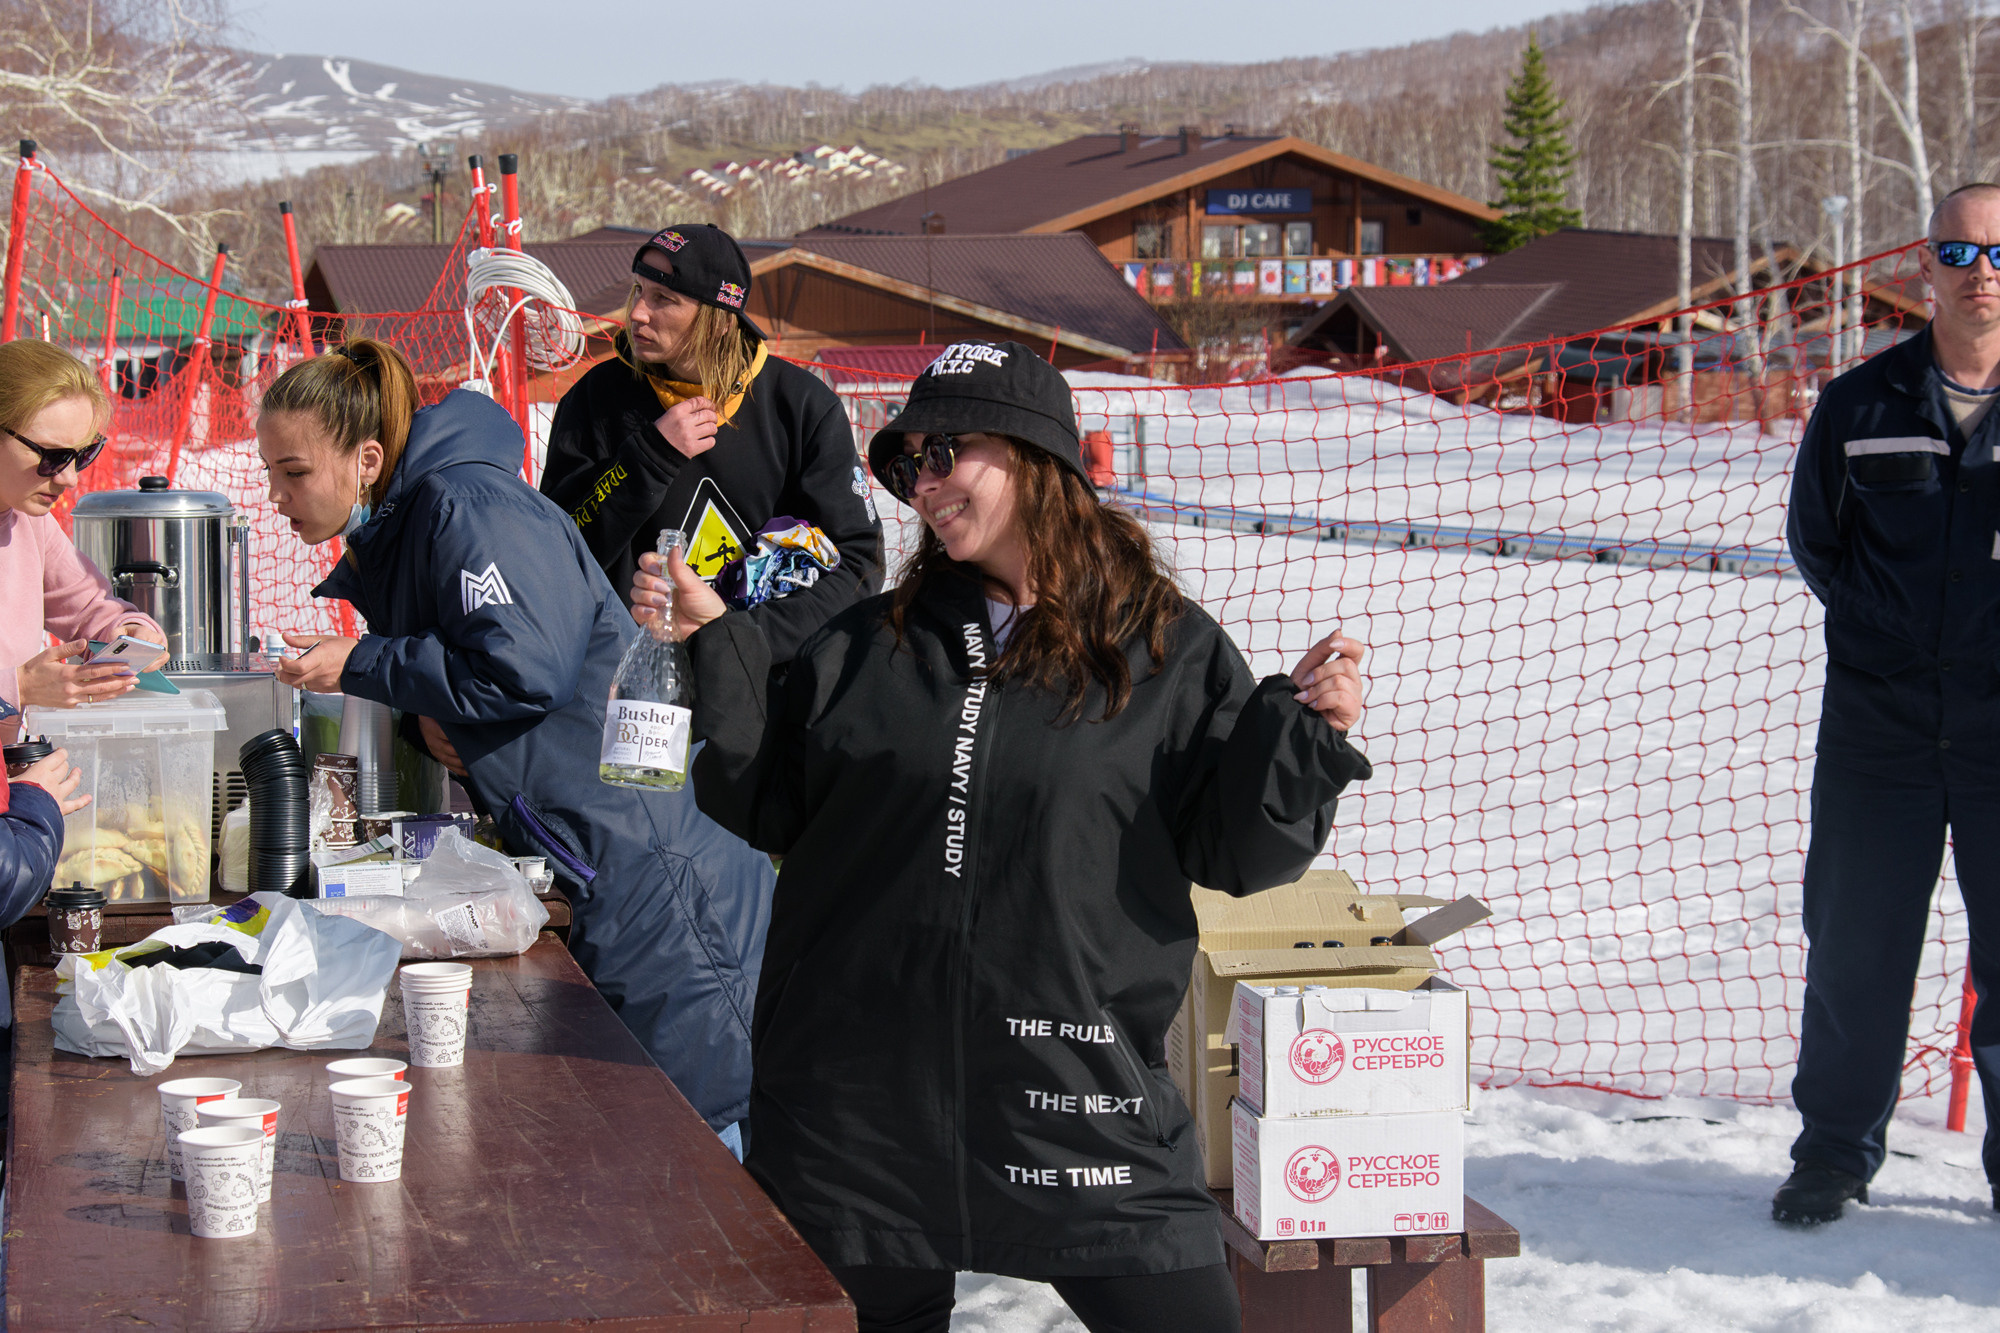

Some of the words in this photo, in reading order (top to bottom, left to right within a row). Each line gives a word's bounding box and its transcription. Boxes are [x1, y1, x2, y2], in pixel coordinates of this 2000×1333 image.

[1227, 193, 1247, 209] DJ
[1251, 193, 1292, 209] CAFE
[962, 622, 987, 669] NAVY
[618, 706, 675, 726] Bushel
[958, 680, 988, 735] STUDY
[951, 736, 975, 794] NAVY
[944, 807, 966, 878] STUDY
[1006, 1017, 1053, 1037] THE
[1352, 1035, 1445, 1053] РУССКОЕ
[1352, 1053, 1445, 1071] СЕРЕБРО
[1025, 1089, 1077, 1113] THE
[1084, 1094, 1144, 1115] NEXT
[1348, 1154, 1440, 1171] РУССКОЕ
[1005, 1164, 1059, 1187] THE
[1066, 1165, 1133, 1188] TIME
[1347, 1171, 1440, 1189] СЕРЕБРО
[1279, 1220, 1292, 1230] 16
[1300, 1219, 1316, 1233] 0,1
[1318, 1221, 1326, 1232] л
